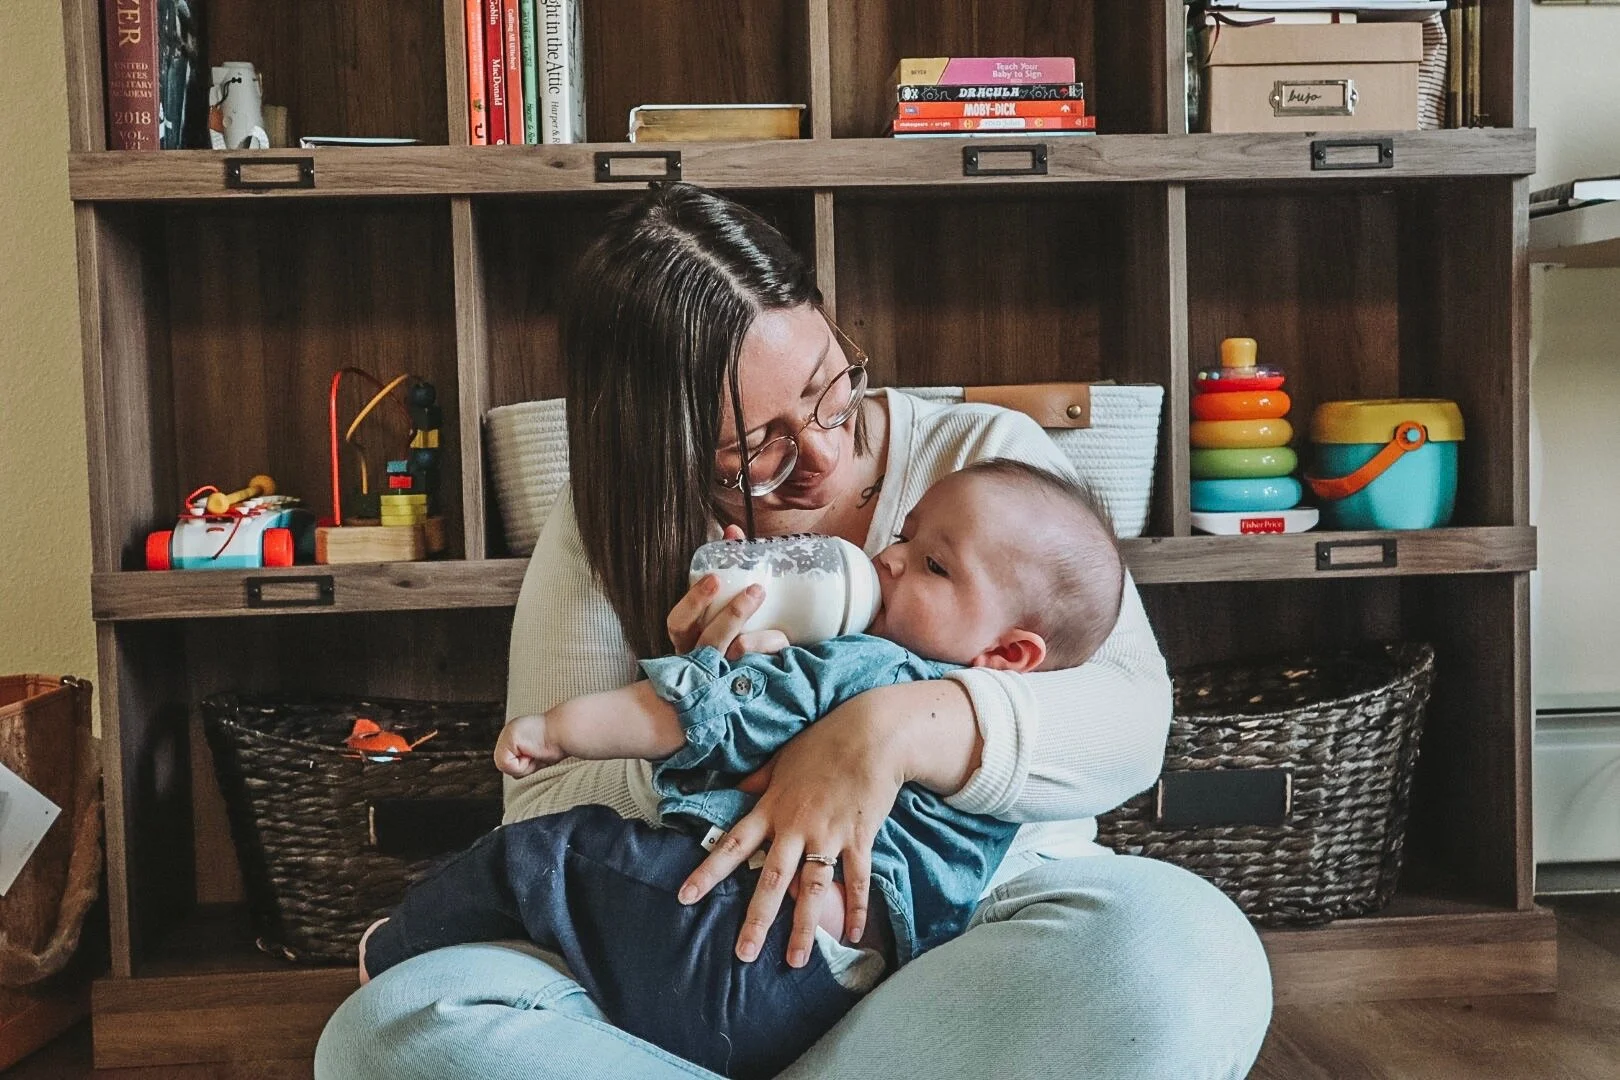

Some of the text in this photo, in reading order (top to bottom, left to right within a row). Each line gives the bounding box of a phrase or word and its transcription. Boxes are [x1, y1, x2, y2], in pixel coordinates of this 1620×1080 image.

[117, 0, 141, 46] ER
[507, 8, 515, 32] Calling
[546, 21, 561, 35] in
[547, 37, 563, 60] the
[113, 62, 149, 70] UNITED
[996, 62, 1038, 70] Teach Your
[546, 61, 564, 94] Attic
[992, 70, 1012, 79] Baby
[1025, 70, 1042, 79] Sign
[491, 59, 503, 106] MacDonald
[958, 87, 1020, 98] DRACULA
[549, 101, 560, 128] Harper
[963, 103, 1016, 117] MOBY-DICK
[114, 111, 152, 125] 2018
[119, 130, 149, 141] VOL.
